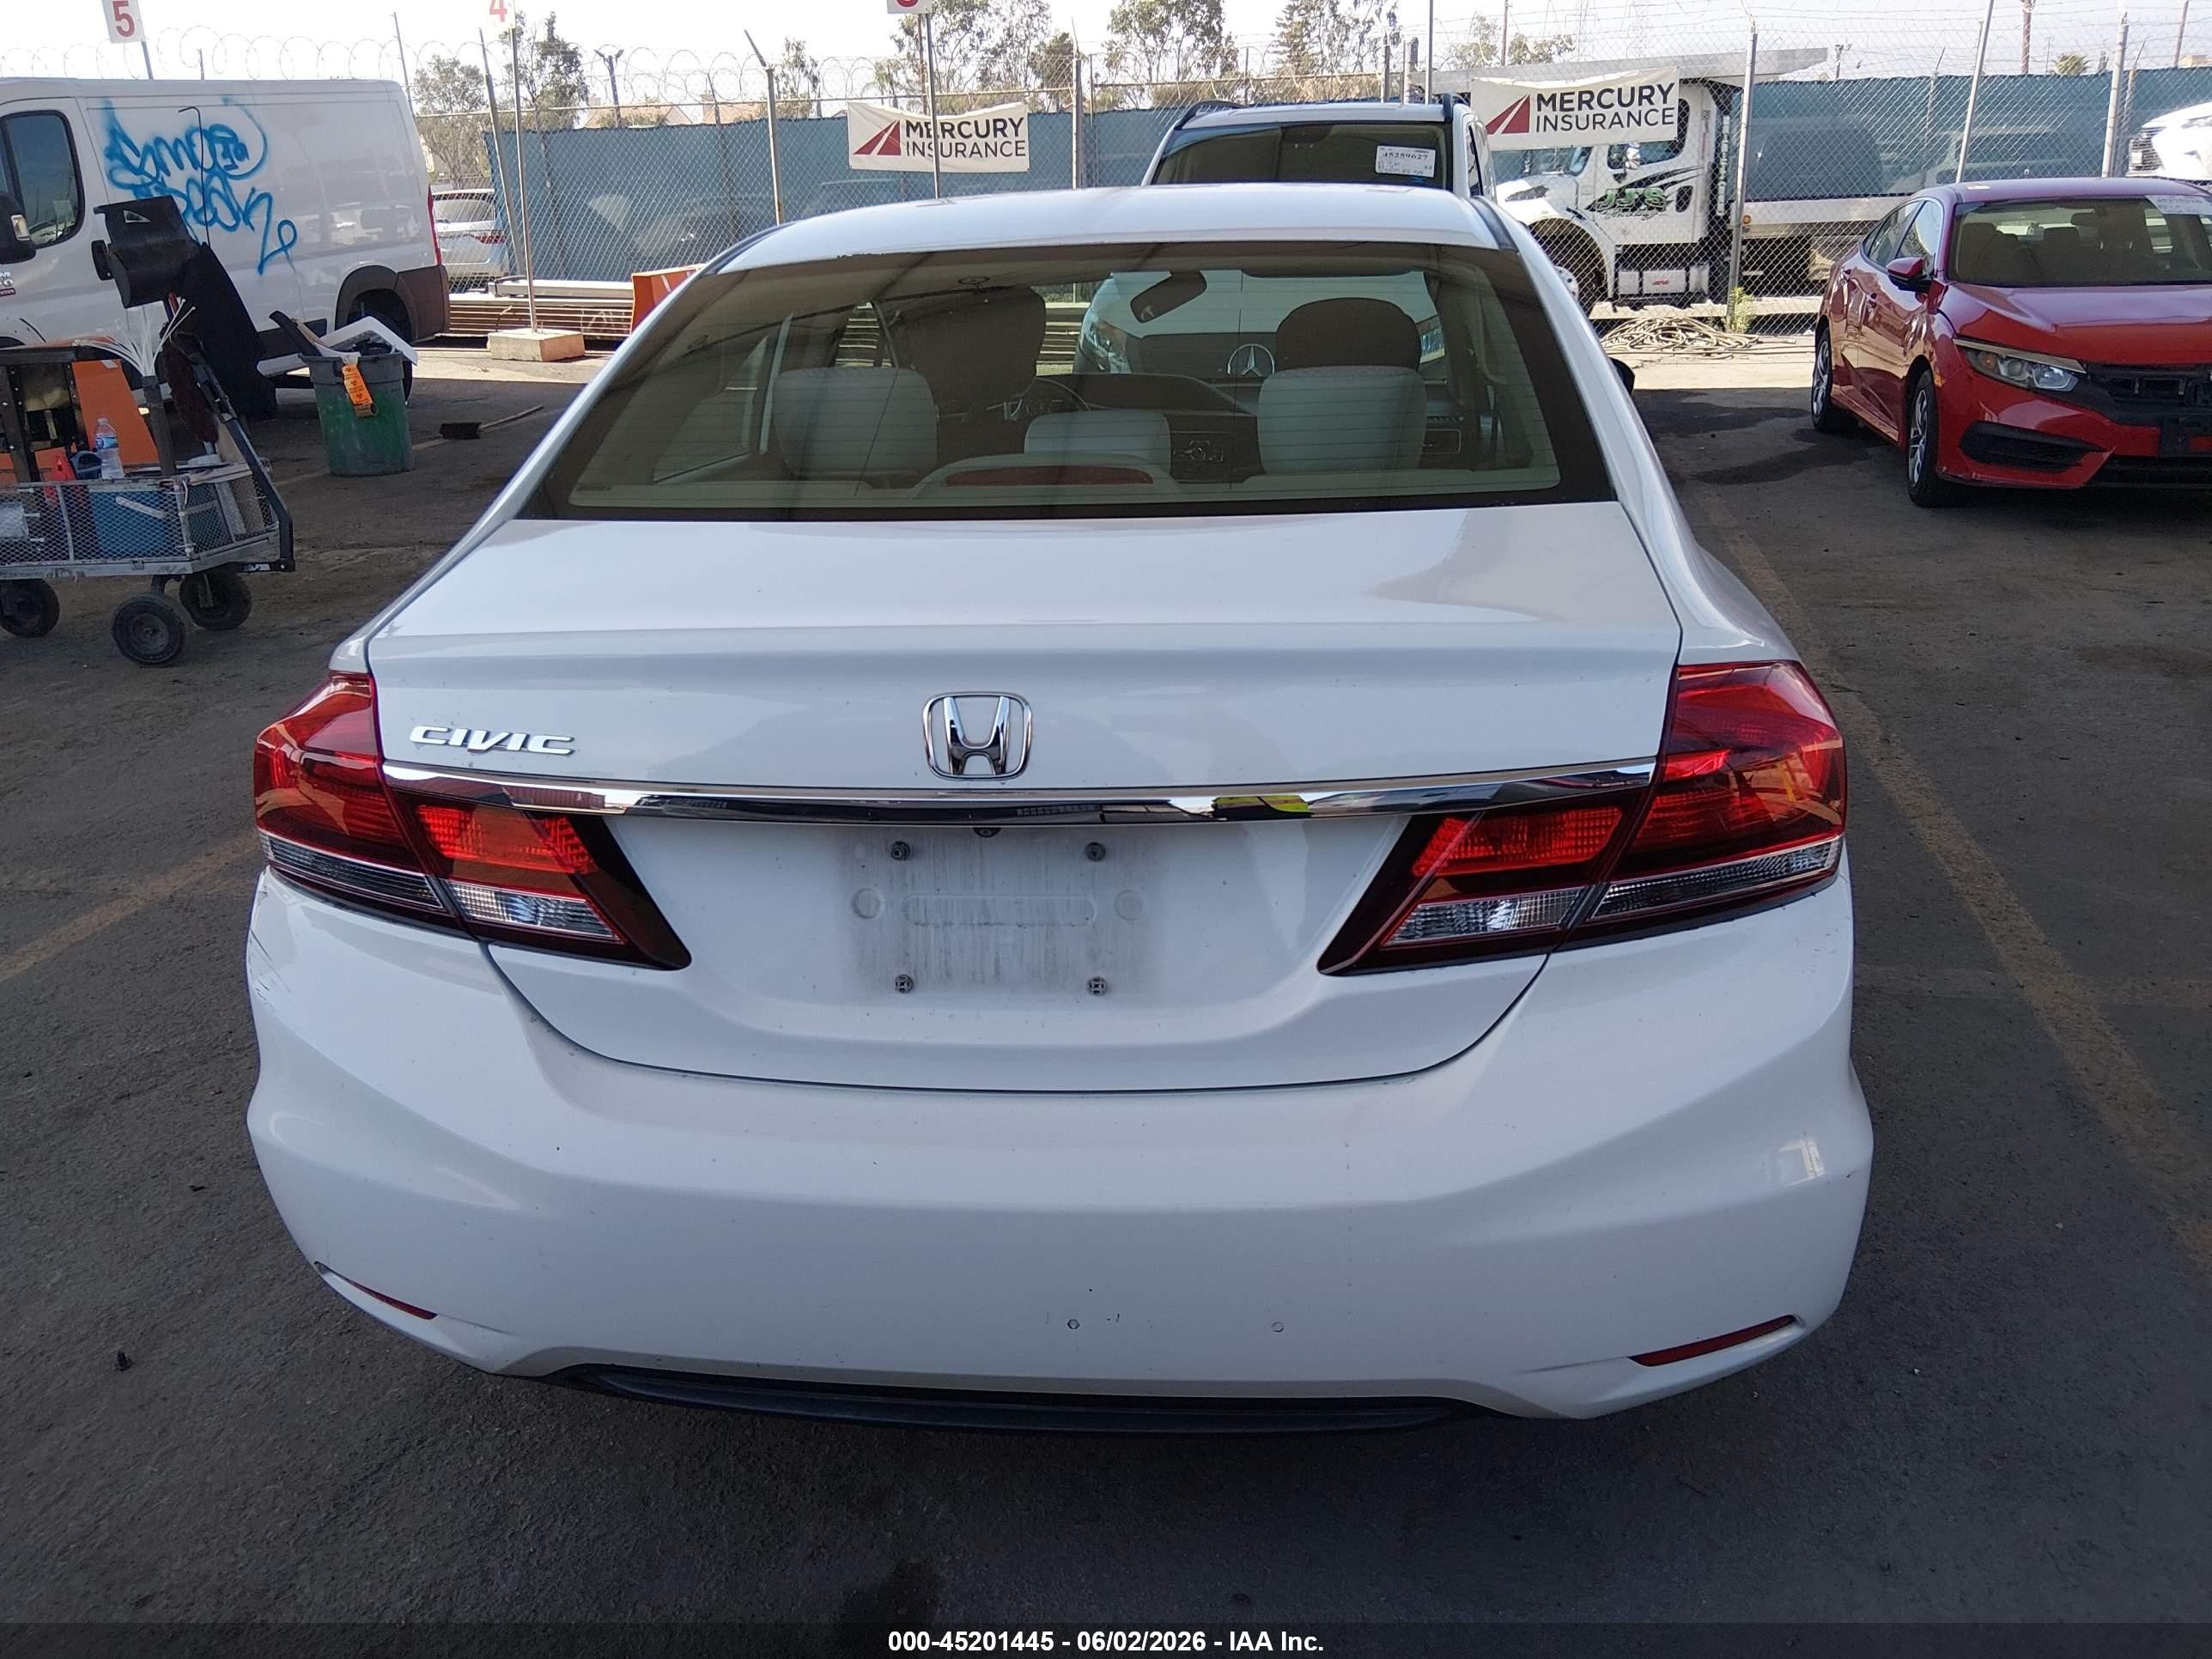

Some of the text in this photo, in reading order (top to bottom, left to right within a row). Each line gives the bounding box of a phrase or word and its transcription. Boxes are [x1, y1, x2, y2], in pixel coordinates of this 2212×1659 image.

[112, 1, 135, 37] 5
[489, 0, 507, 22] 4
[1537, 82, 1676, 112] MERCURY
[905, 118, 1024, 139] MERCURY
[1536, 106, 1674, 132] INSURANCE
[410, 726, 574, 755] CIVIC
